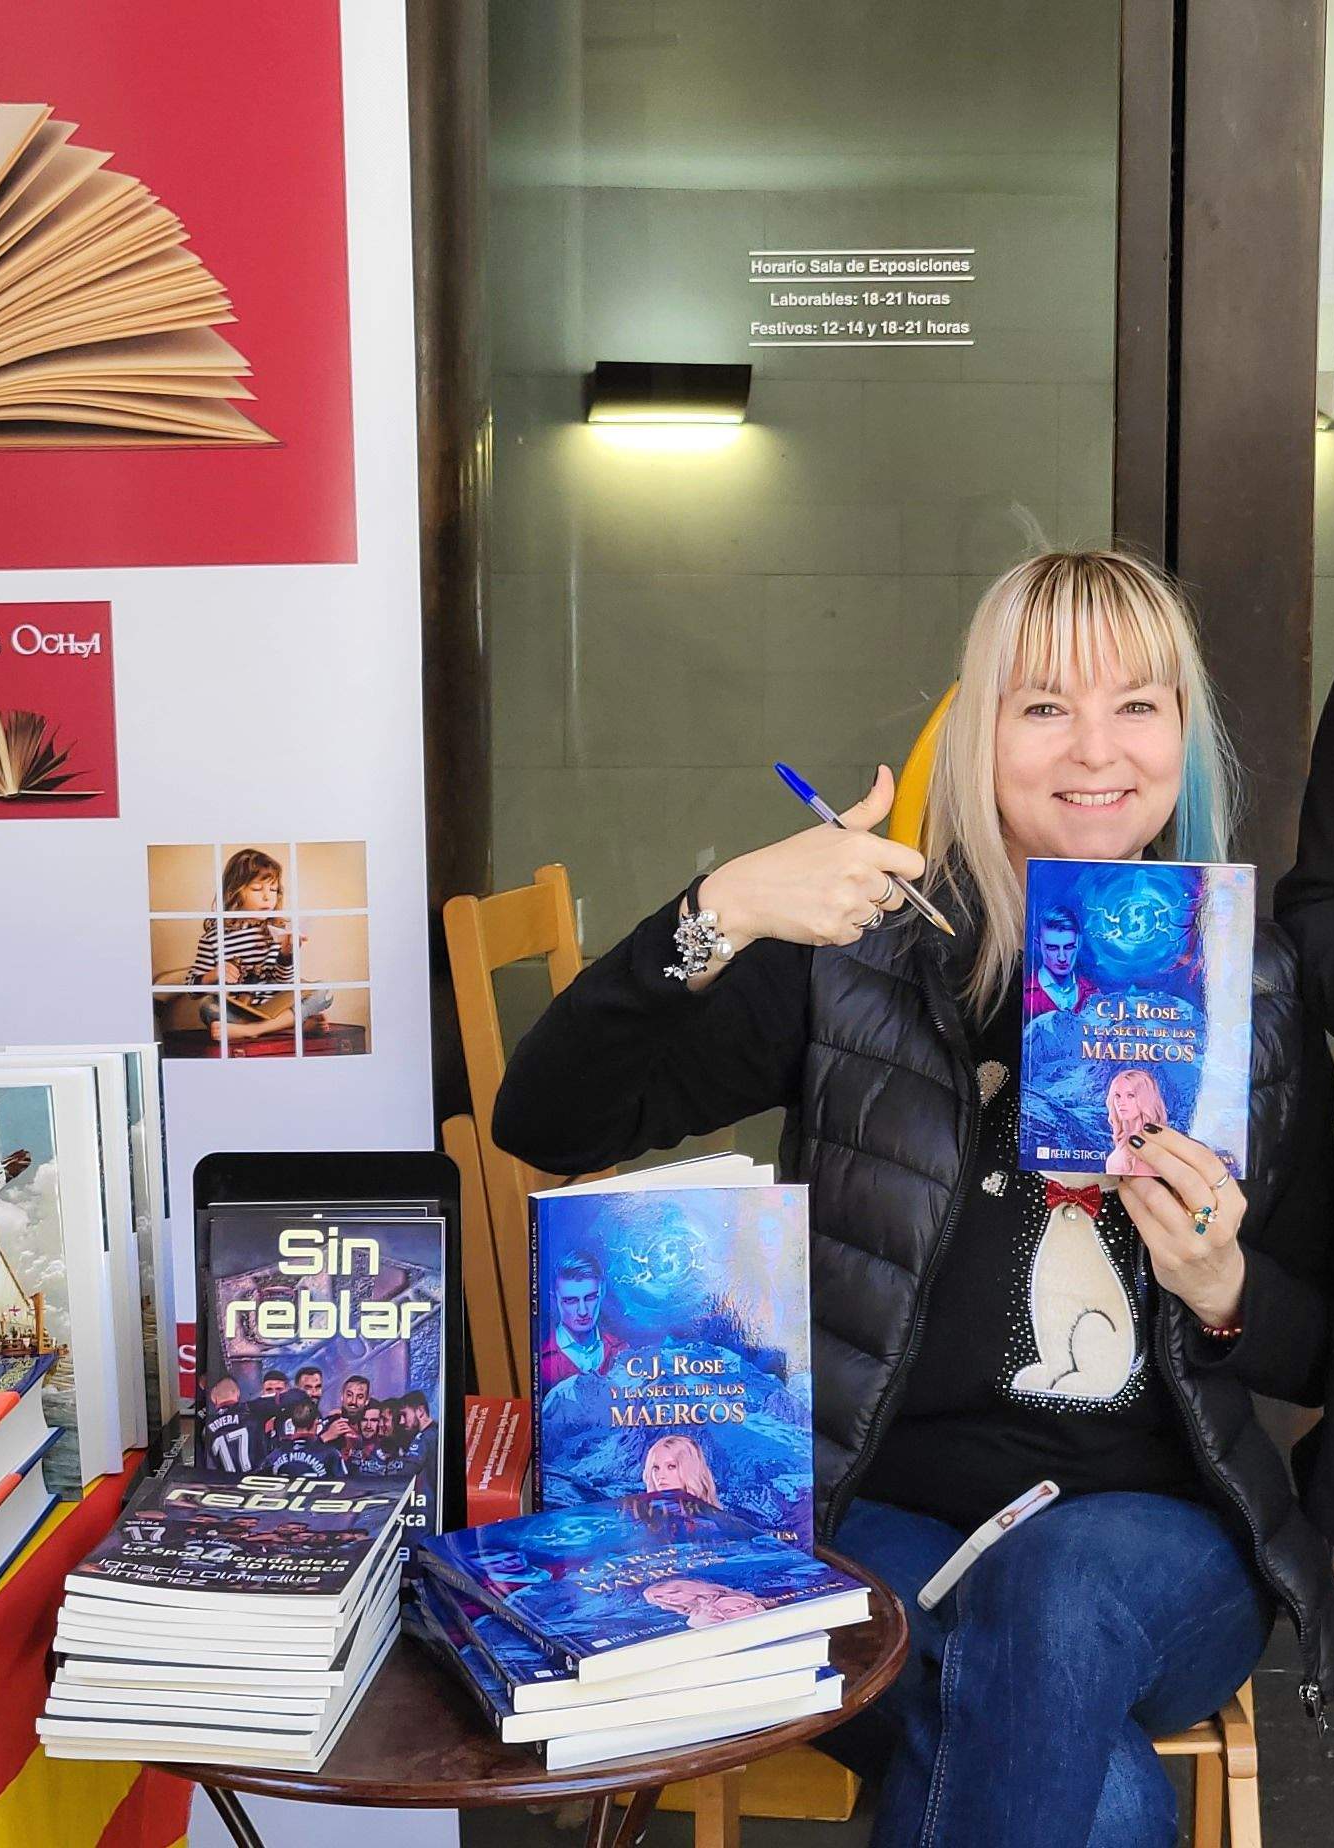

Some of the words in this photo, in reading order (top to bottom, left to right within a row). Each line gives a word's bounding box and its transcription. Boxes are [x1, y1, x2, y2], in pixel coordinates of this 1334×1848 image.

[751, 260, 805, 274] Horario
[810, 260, 842, 273] Sala
[846, 259, 865, 273] de
[869, 258, 970, 276] Exposiciones
[770, 292, 858, 307] Laborables:
[862, 292, 903, 306] 18-21
[908, 292, 950, 306] horas
[750, 321, 818, 336] Festivos:
[821, 321, 864, 335] 12-14
[867, 324, 876, 337] y
[880, 321, 922, 334] 18-21
[927, 320, 969, 334] horas
[1081, 1040, 1195, 1063] MAERCOS
[278, 1227, 380, 1276] Sin
[225, 1289, 432, 1340] reblar
[647, 1384, 690, 1398] SECTA
[718, 1383, 745, 1396] LOS
[207, 1414, 240, 1434] RIVERA
[610, 1402, 746, 1428] MAERCOS
[211, 1426, 253, 1474] 17
[237, 1475, 346, 1494] Sin
[166, 1487, 391, 1514] reblar
